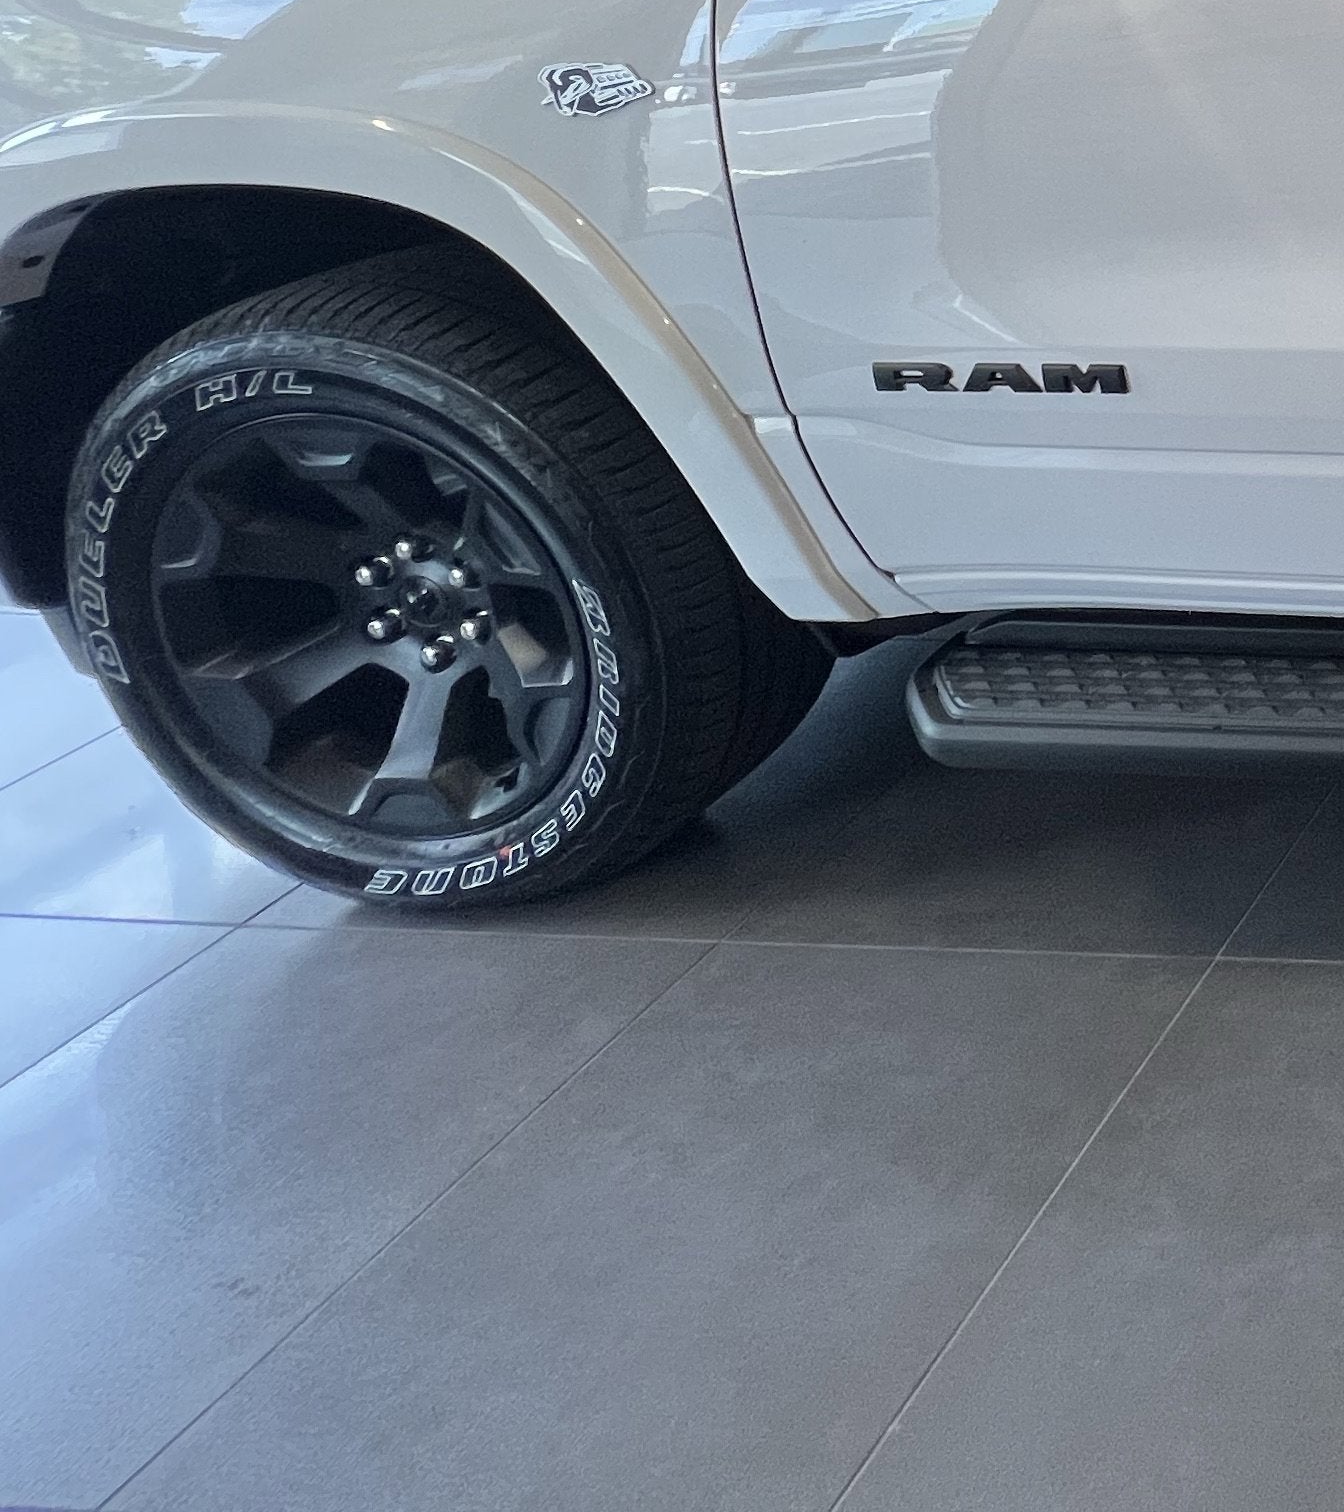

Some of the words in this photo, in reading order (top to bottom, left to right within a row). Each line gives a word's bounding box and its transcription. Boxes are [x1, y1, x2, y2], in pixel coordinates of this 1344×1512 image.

[78, 409, 168, 685] DUELER
[194, 369, 313, 412] H/L
[871, 361, 1131, 394] RAM
[363, 577, 621, 897] BRIDGESTONE
